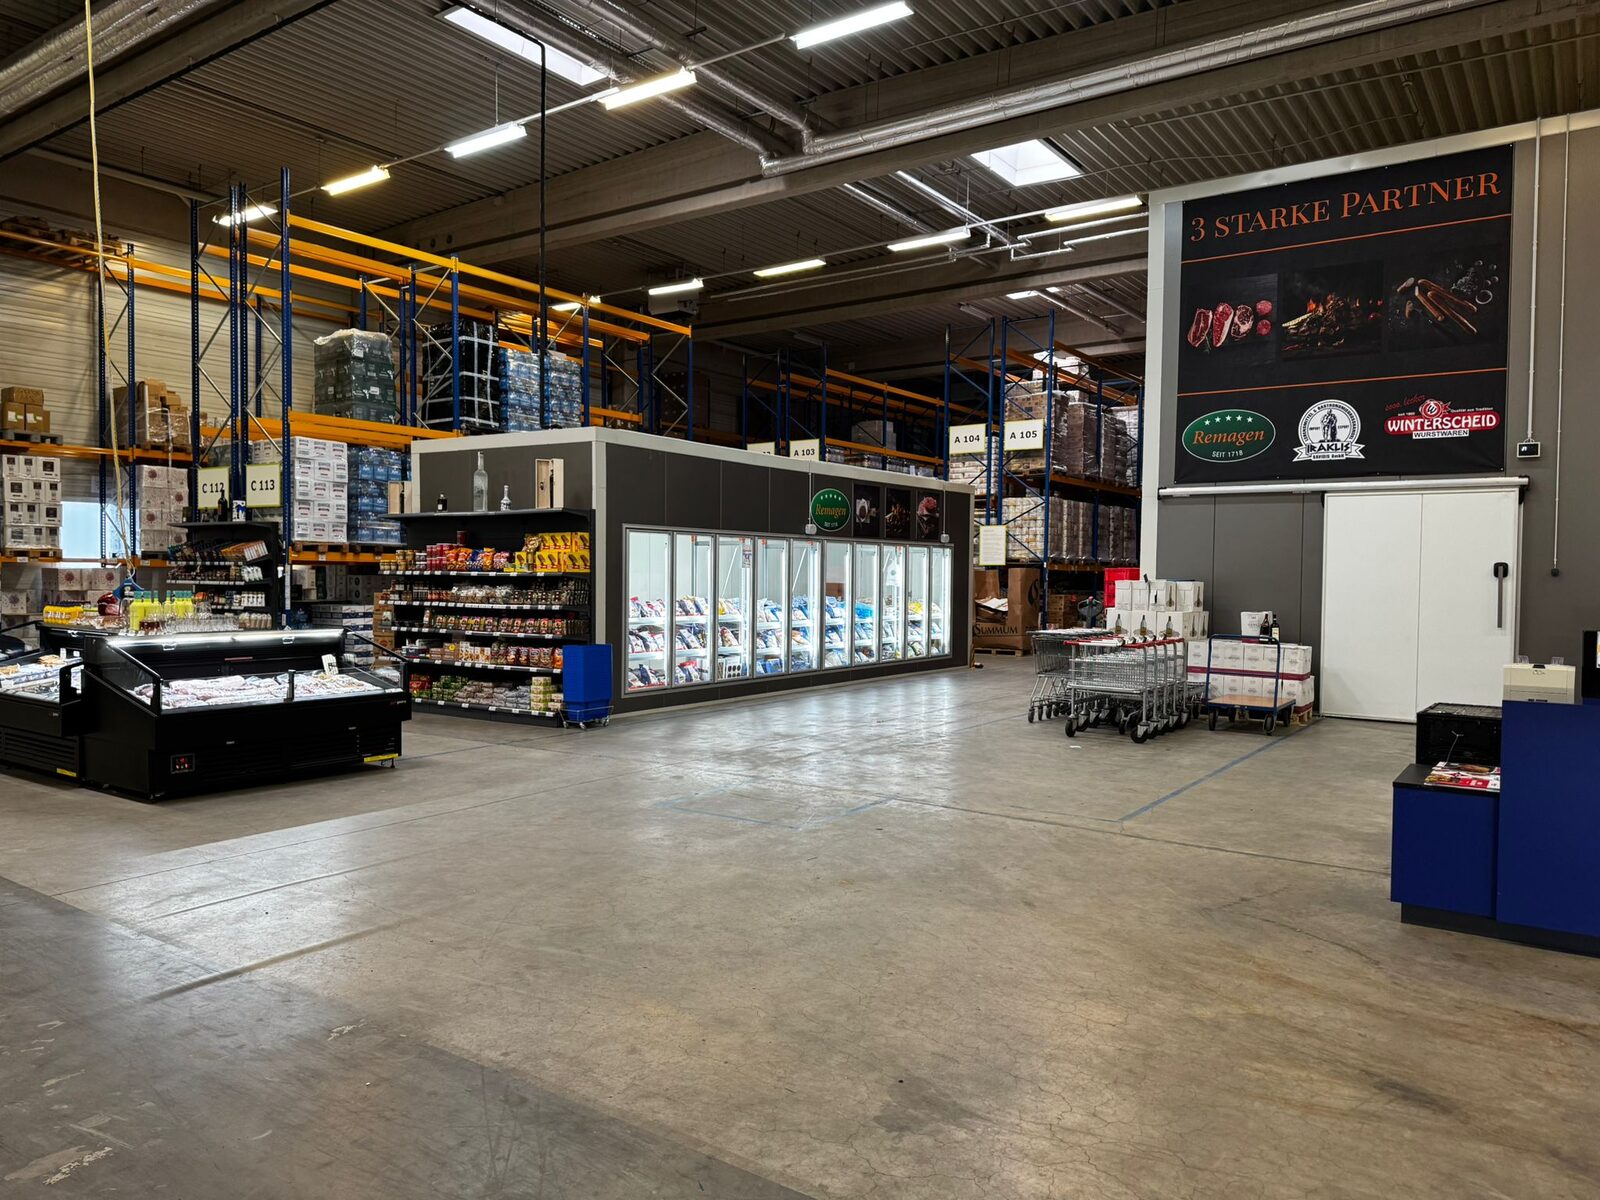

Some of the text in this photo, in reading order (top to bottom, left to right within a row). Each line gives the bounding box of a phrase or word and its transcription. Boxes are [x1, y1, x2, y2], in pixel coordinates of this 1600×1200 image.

[1190, 172, 1501, 242] 3 STARKE PARTNER
[1387, 414, 1496, 432] WINTERSCHEID
[964, 435, 980, 443] 104
[1020, 430, 1037, 439] 105
[1192, 430, 1265, 446] Remagen
[1413, 430, 1468, 438] WURSTWAREN
[1211, 450, 1225, 458] SEIT
[202, 482, 225, 494] C 112
[250, 479, 275, 491] C 113
[815, 503, 847, 519] Remagen
